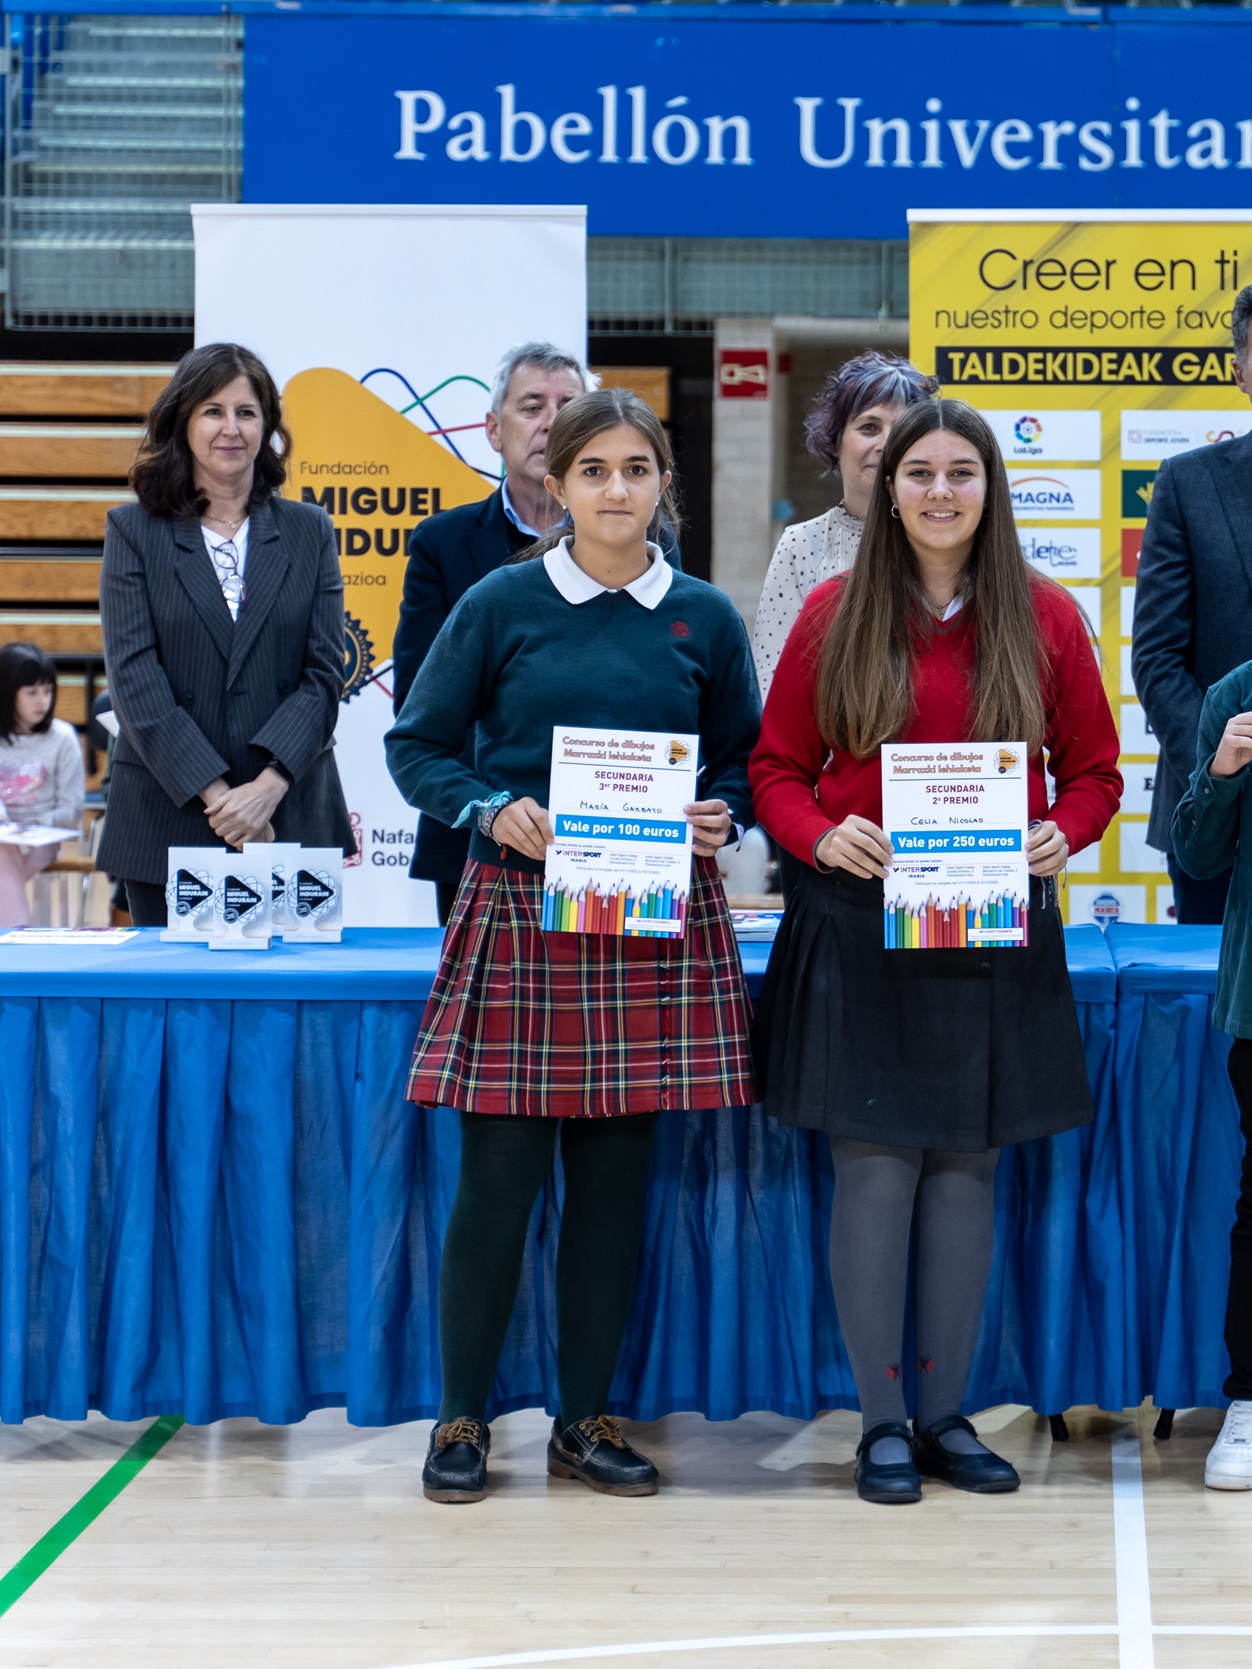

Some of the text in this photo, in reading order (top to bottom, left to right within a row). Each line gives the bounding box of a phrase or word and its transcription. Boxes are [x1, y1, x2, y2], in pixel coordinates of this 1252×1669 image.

[393, 81, 755, 165] Pabellón
[978, 248, 1238, 291] Creer en ti
[935, 305, 1039, 329] nuestro
[1049, 304, 1165, 334] deporte
[948, 352, 1163, 382] TALDEKIDEAK
[1013, 445, 1043, 455] LaLiga
[300, 461, 389, 475] Fundación
[301, 486, 450, 516] MIGUEL
[1010, 491, 1074, 504] MAGNA
[341, 571, 387, 586] azioa
[562, 736, 655, 752] Concurso de dibujos
[891, 752, 984, 762] Concurso de dibujos
[594, 771, 654, 782] SECUNDARIA
[613, 784, 648, 793] PREMIO
[926, 785, 985, 793] SECUNDARIA
[563, 820, 679, 838] Vale por 100 euros
[898, 836, 1014, 849] Vale por 250 euros
